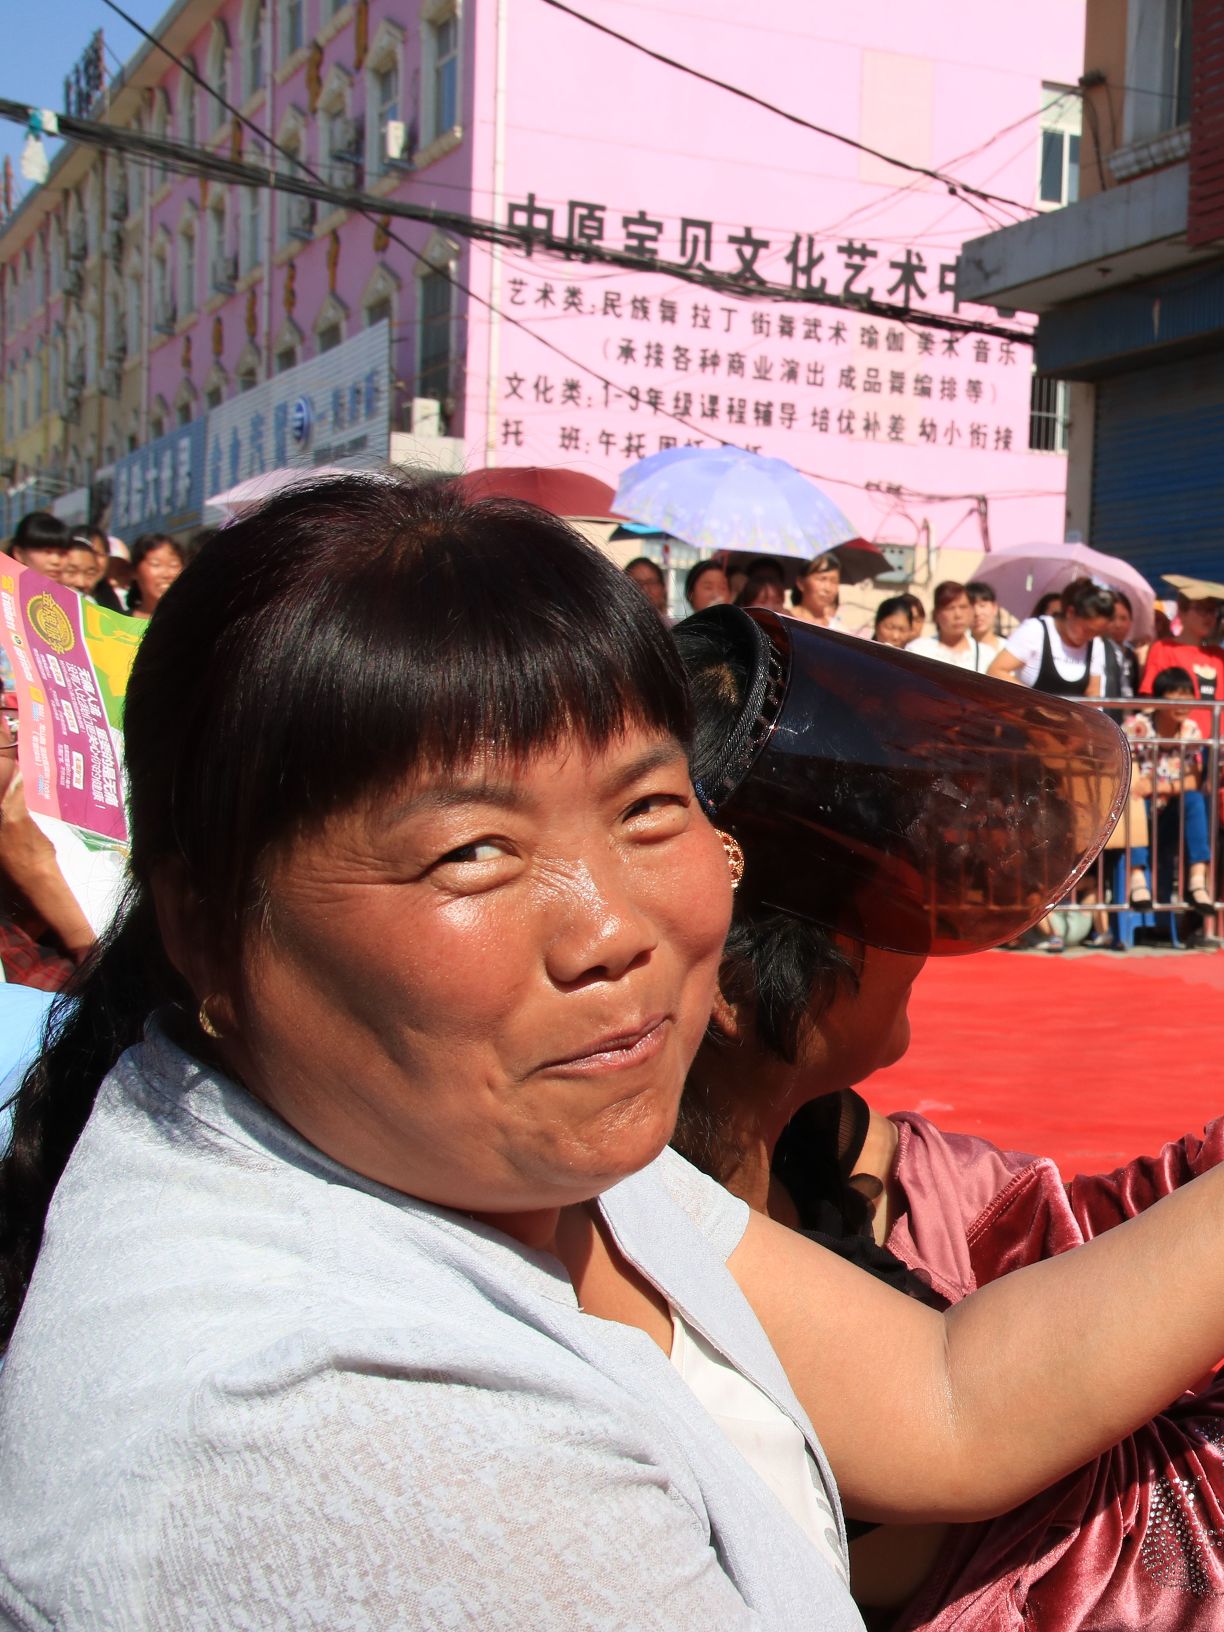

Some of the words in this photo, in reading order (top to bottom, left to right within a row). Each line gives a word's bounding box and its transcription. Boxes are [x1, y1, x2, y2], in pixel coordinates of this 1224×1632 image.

[507, 192, 1016, 318] 中原宝贝文化艺术中
